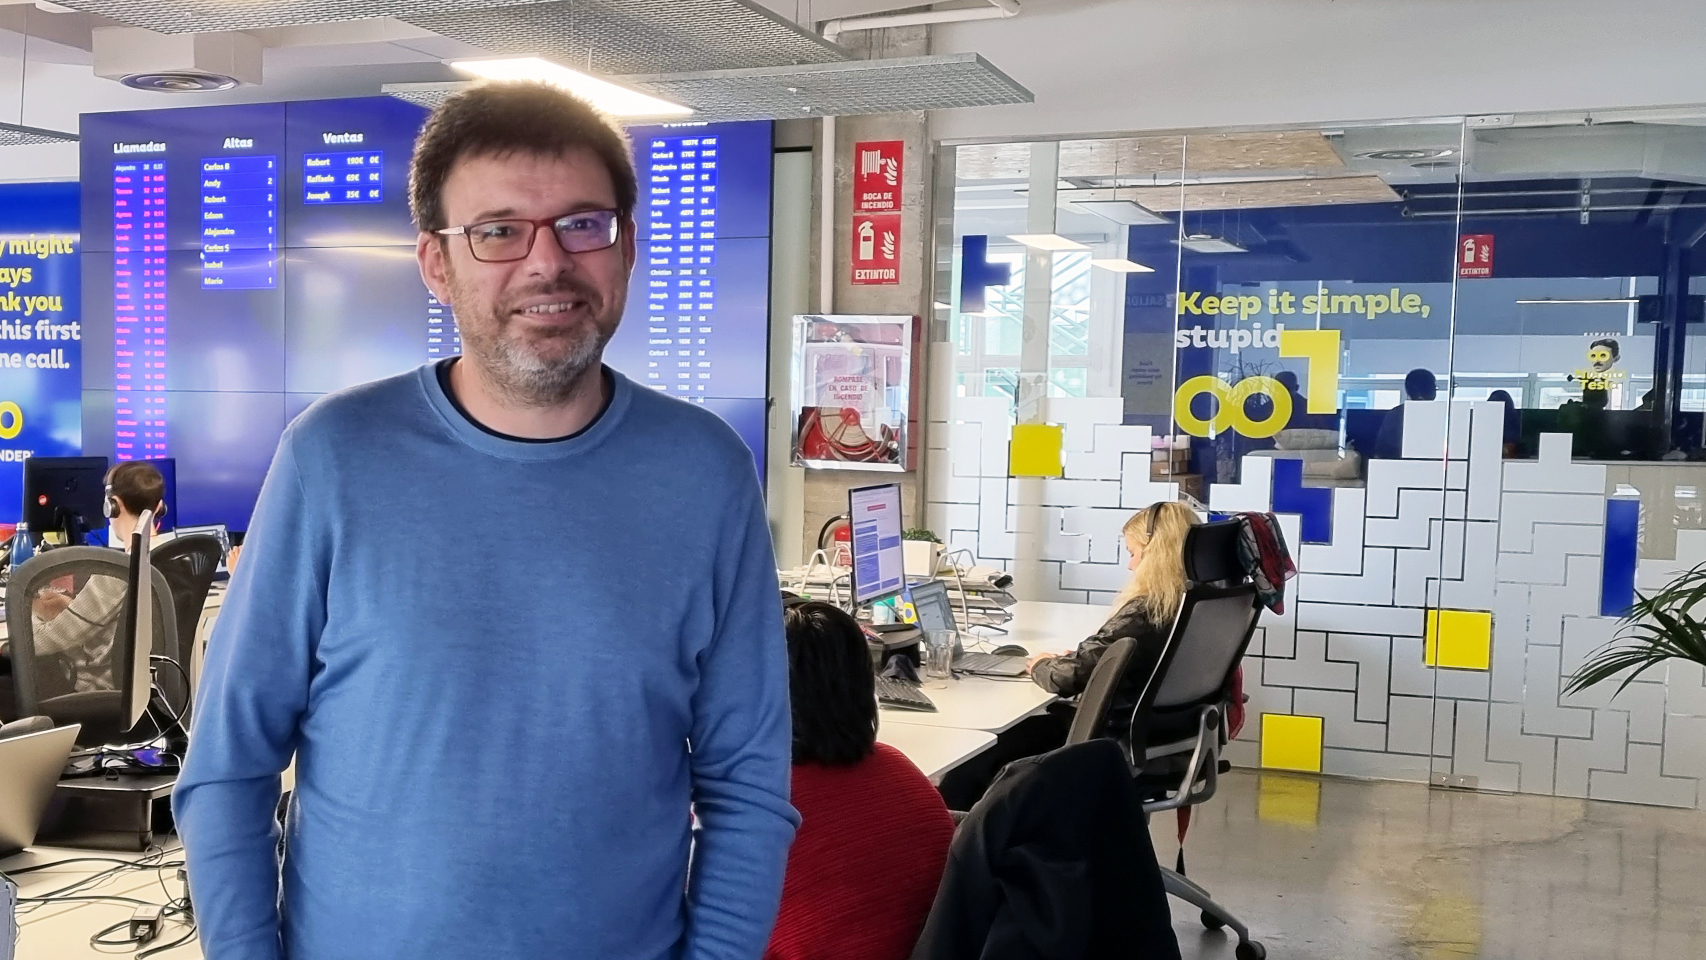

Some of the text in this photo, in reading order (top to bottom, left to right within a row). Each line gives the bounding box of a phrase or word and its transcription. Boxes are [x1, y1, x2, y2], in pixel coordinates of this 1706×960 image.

[223, 137, 254, 149] Altas
[323, 132, 364, 144] Ventas
[114, 140, 167, 154] Llamadas
[204, 162, 224, 171] Carlos
[307, 158, 330, 166] Robert
[204, 180, 222, 189] Andy
[204, 195, 226, 204] Robert
[307, 191, 330, 201] Joseph
[862, 192, 893, 200] BOCA DE
[861, 201, 894, 209] INCENDIO
[204, 227, 236, 237] Alejandro
[9, 234, 74, 259] might
[204, 243, 224, 252] Carlos
[855, 269, 896, 280] EXTINTOR
[1460, 267, 1489, 275] EXTINTOR
[204, 277, 224, 285] Mario
[23, 295, 63, 316] you
[1178, 288, 1431, 321] Keep it simple,
[35, 319, 81, 340] first
[1176, 322, 1285, 354] stupid
[25, 348, 70, 369] call.
